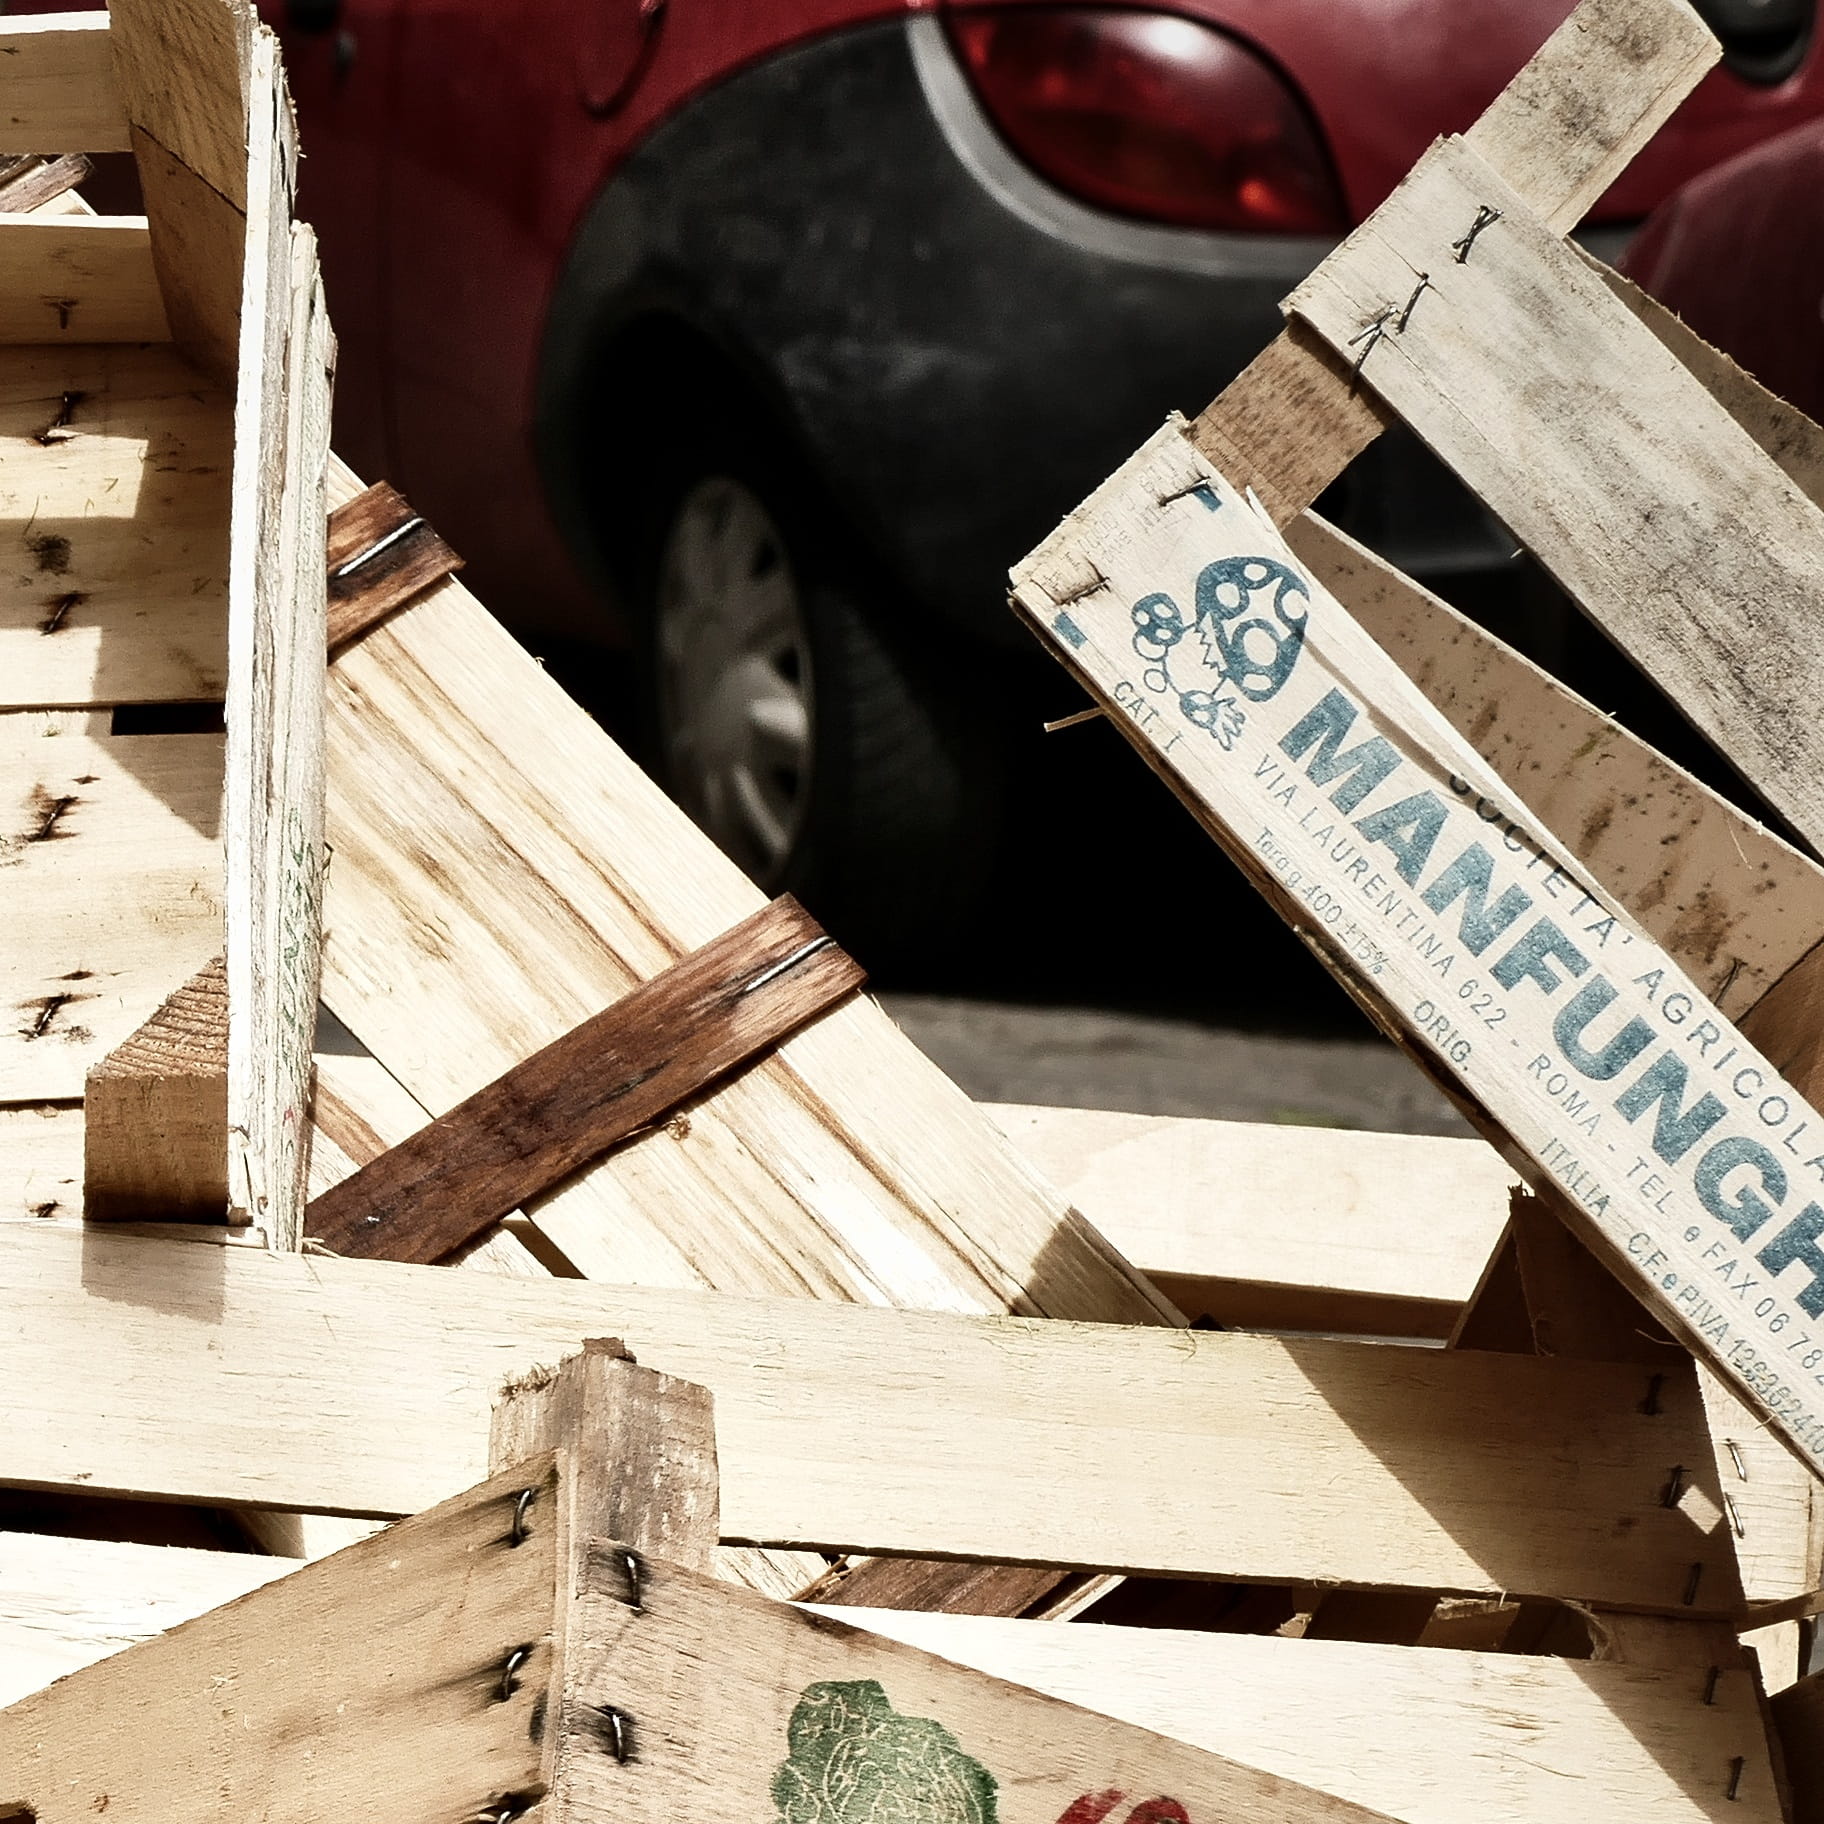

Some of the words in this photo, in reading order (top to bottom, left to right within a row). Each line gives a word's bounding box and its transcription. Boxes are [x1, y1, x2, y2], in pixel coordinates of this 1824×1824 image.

[1109, 676, 1166, 736] CAT.
[1249, 824, 1297, 875] Tara
[1248, 751, 1305, 810] VIA
[1295, 801, 1460, 983] LAURENTINA
[1454, 974, 1511, 1033] 622
[1526, 1050, 1608, 1139] ROMA
[1620, 1154, 1679, 1217] TEL
[1701, 1239, 1759, 1301] FAX
[1408, 995, 1482, 1075] ORIG.
[1537, 1135, 1616, 1220] ITALIA
